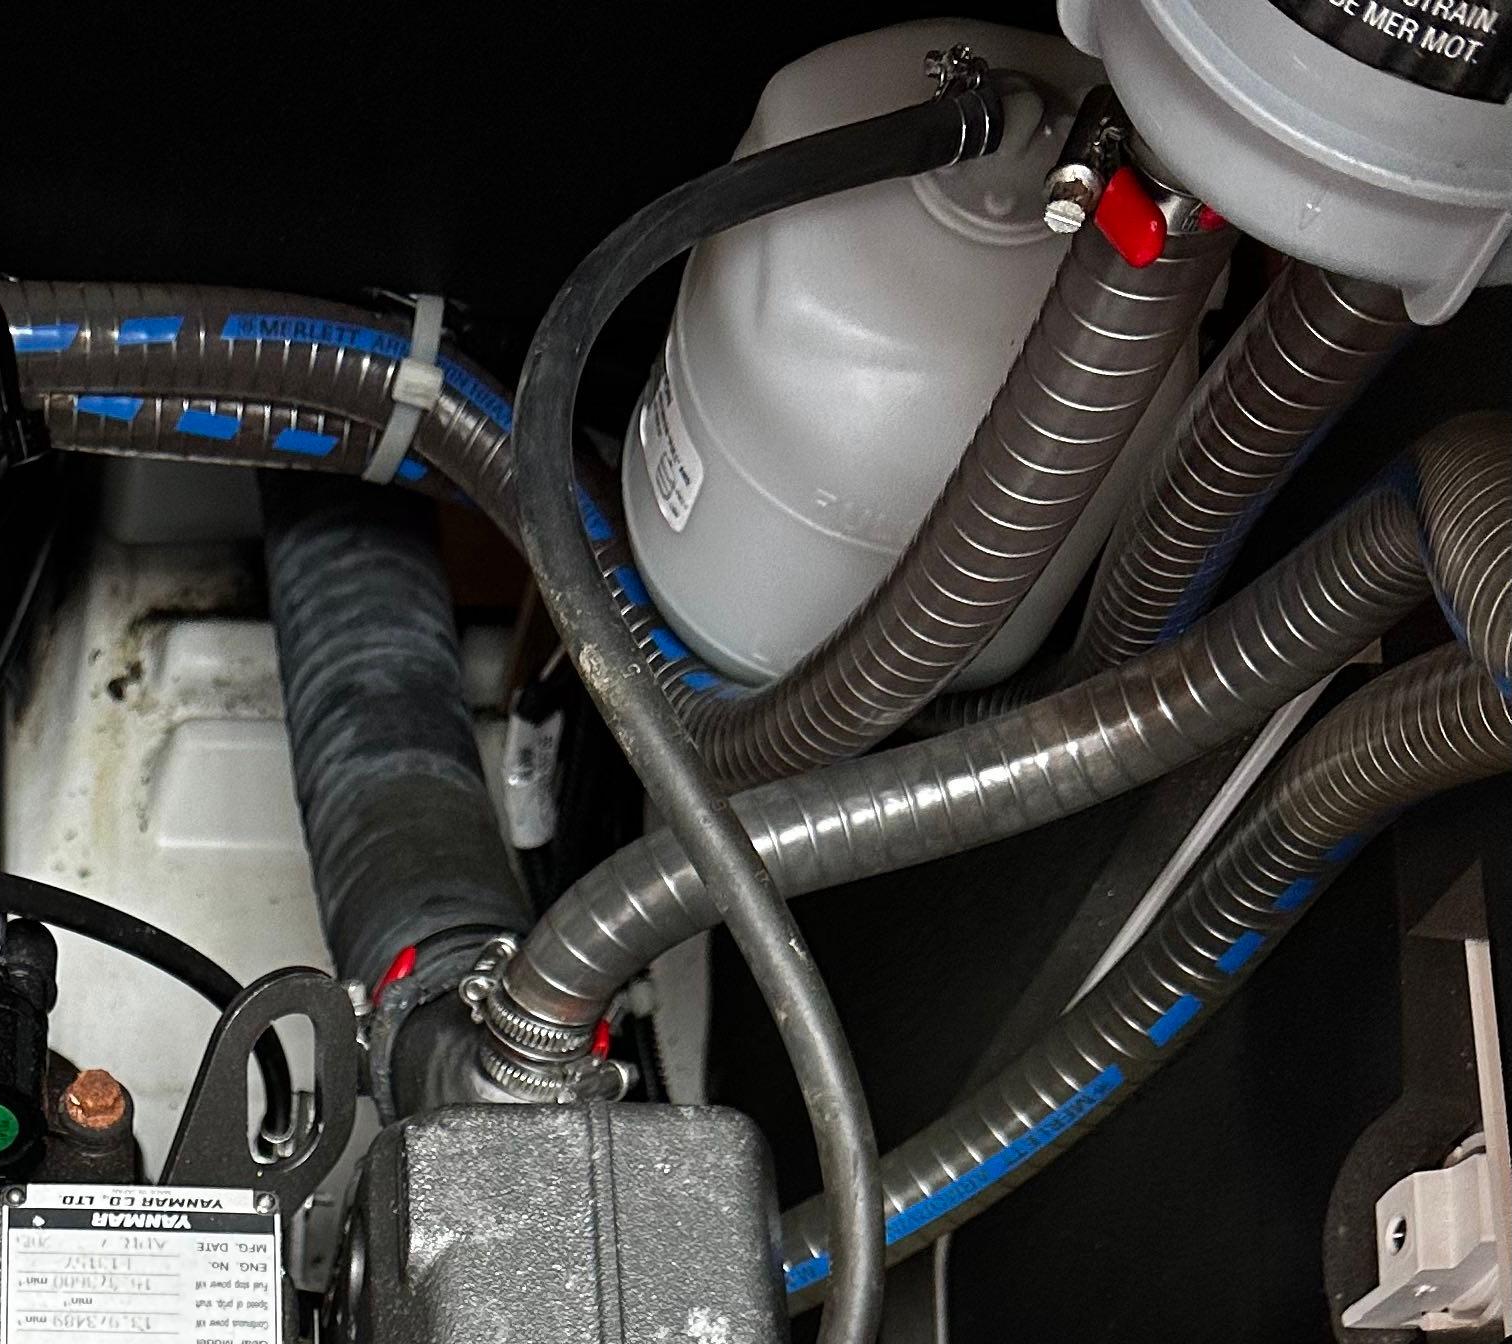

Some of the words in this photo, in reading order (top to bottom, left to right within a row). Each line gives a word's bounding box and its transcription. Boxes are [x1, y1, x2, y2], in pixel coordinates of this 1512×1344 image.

[1363, 1, 1419, 43] MER
[1421, 27, 1484, 64] MOT.
[59, 1195, 94, 1205] LTD.
[142, 1196, 223, 1209] YANMAR
[91, 1212, 191, 1229] YANMAR
[197, 1242, 228, 1252] DATE
[253, 1281, 268, 1291] Fuel
